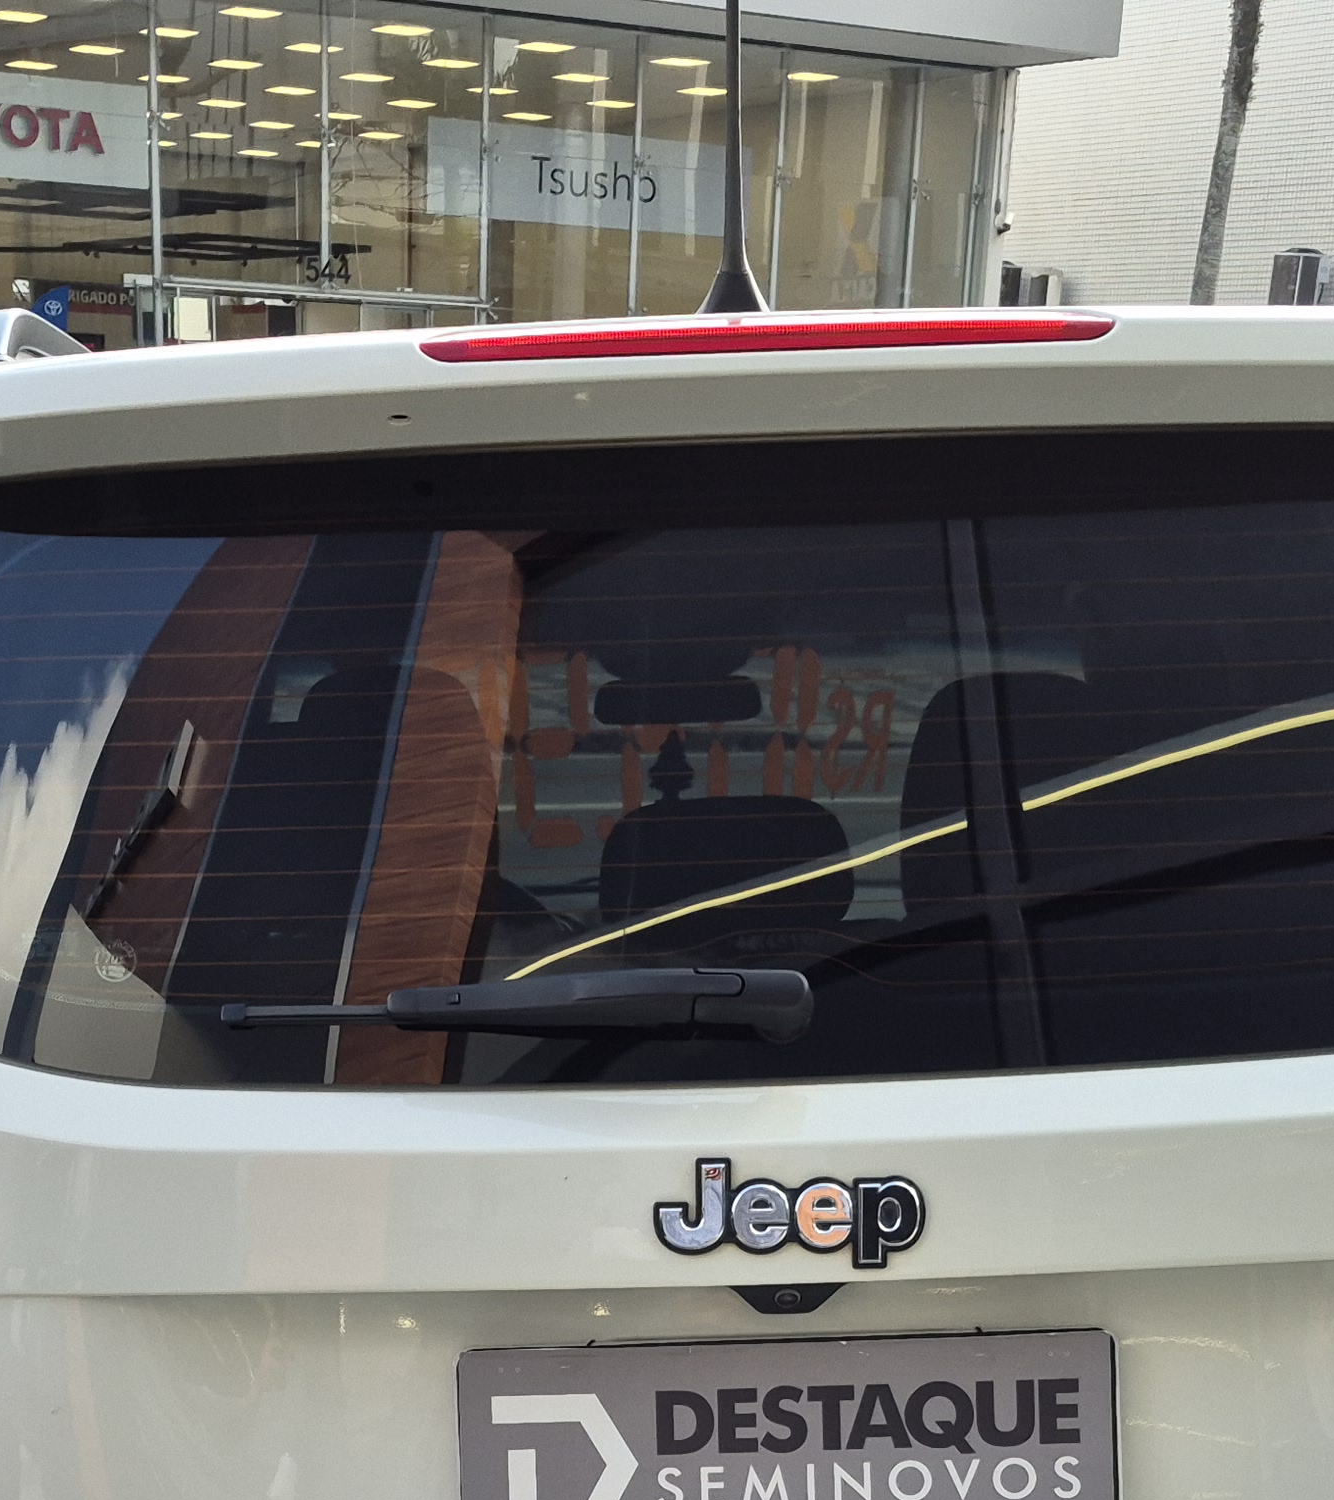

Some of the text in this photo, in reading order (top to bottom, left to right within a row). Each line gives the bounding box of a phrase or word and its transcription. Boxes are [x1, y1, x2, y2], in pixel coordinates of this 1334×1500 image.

[531, 155, 657, 204] Tsusho
[304, 256, 352, 285] 544
[654, 1157, 926, 1269] Jeep
[654, 1377, 1082, 1455] DESTAQUE
